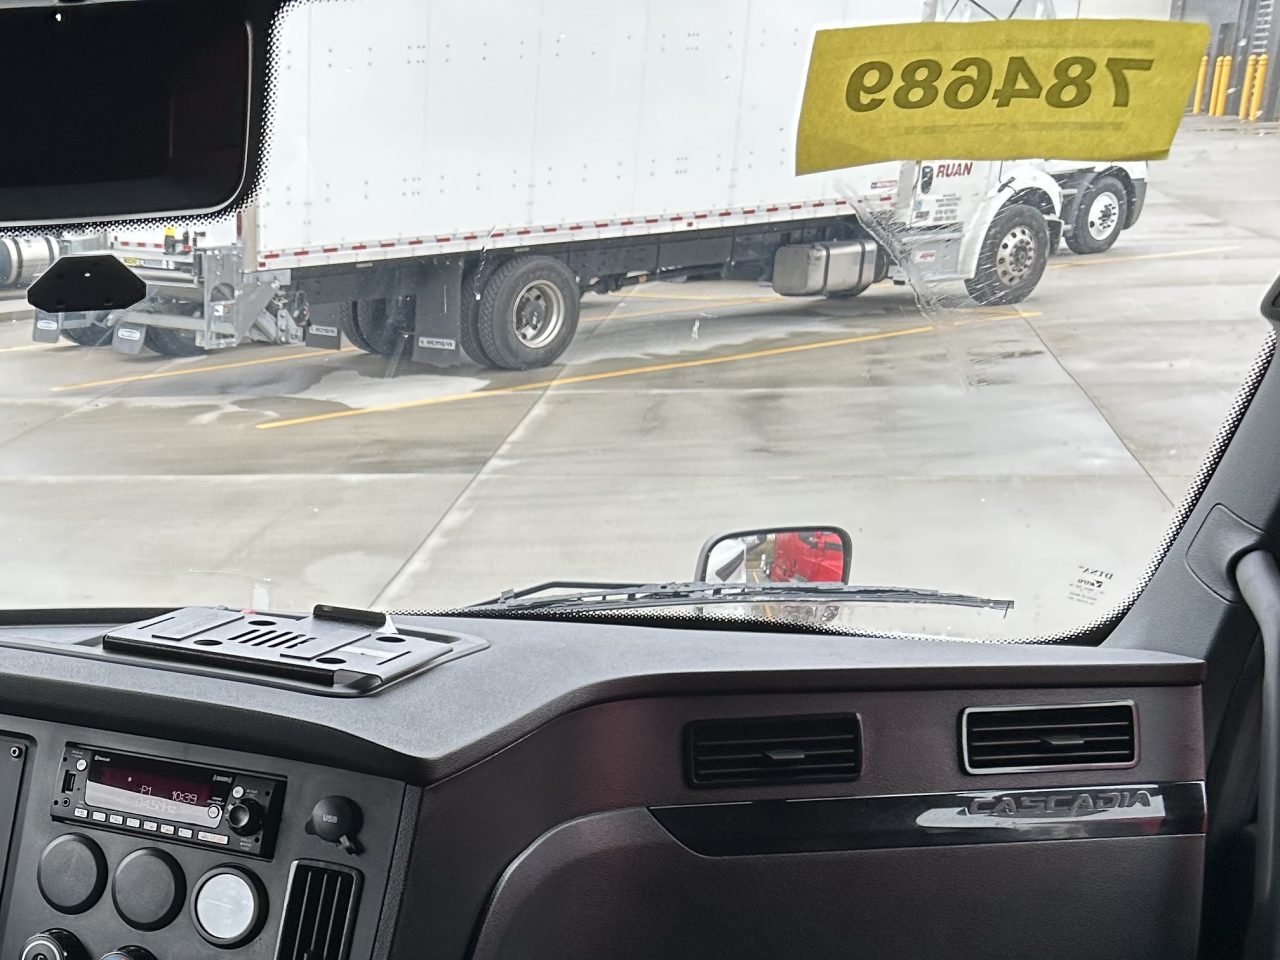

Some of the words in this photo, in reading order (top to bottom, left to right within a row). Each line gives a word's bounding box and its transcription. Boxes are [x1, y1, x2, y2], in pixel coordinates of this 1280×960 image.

[936, 162, 973, 178] RUAN
[171, 789, 198, 805] 10:39
[970, 790, 1152, 816] CASCADIA
